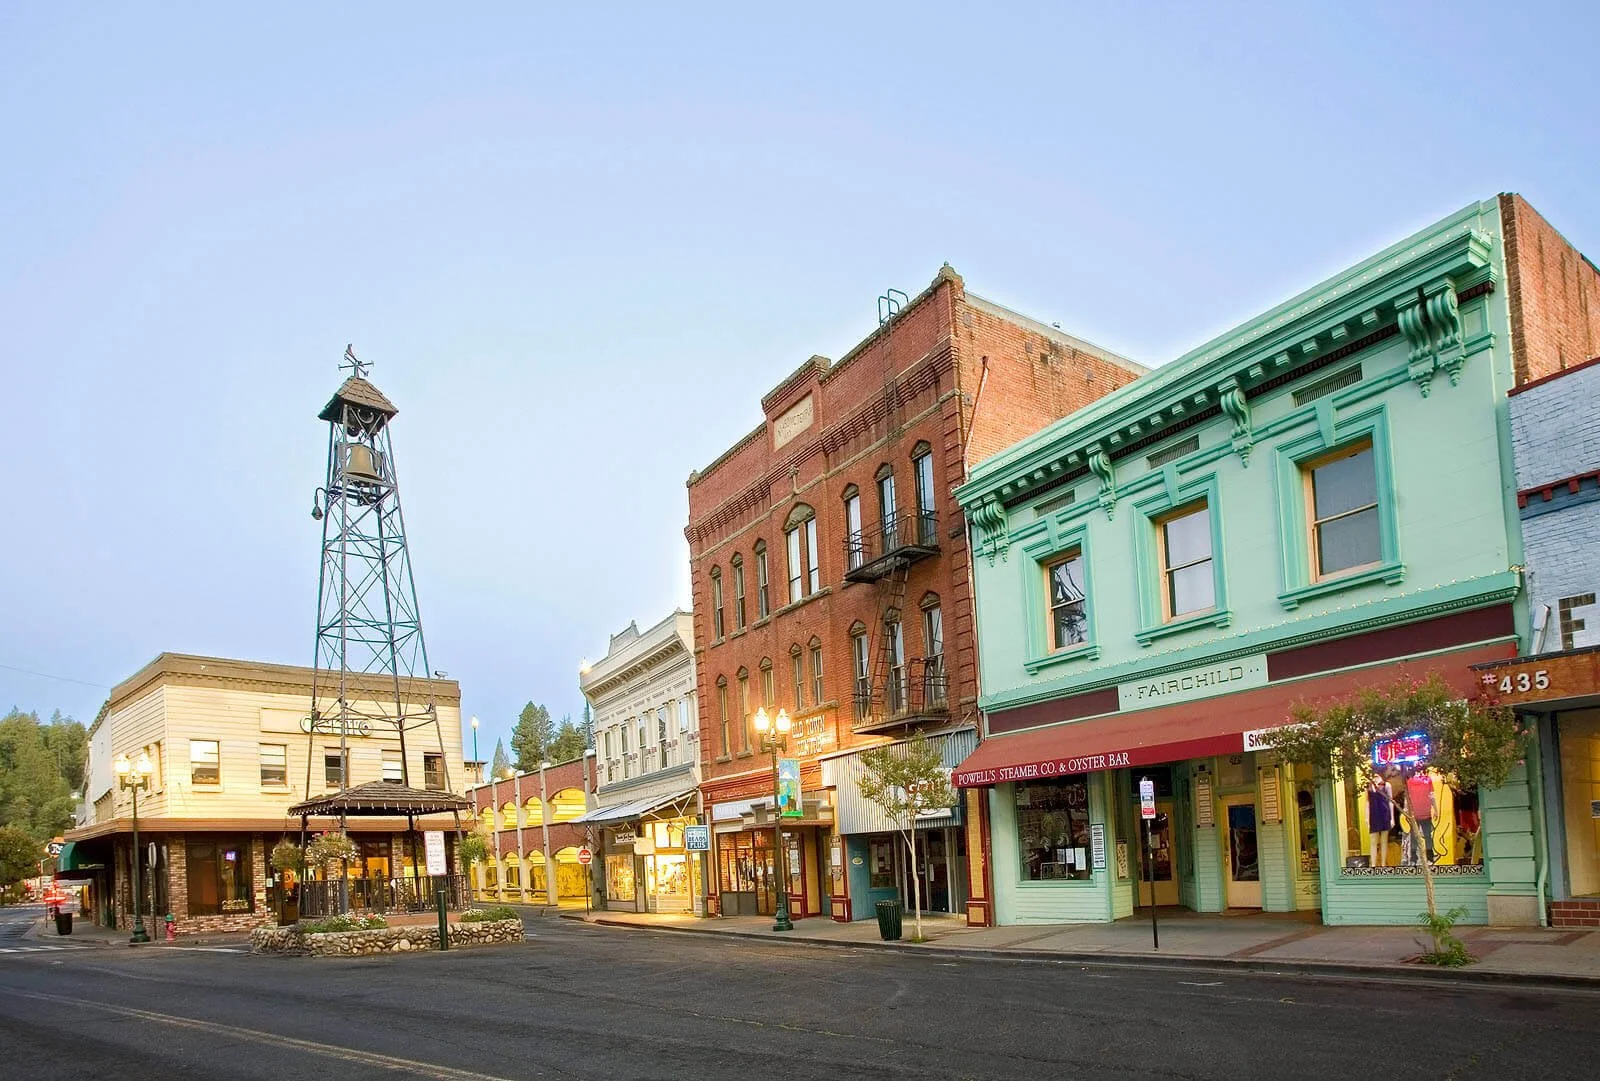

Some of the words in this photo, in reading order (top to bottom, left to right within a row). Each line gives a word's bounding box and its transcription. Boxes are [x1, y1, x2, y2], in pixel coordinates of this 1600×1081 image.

[1137, 666, 1243, 699] FAIRCHILD
[1481, 670, 1549, 694] #435
[792, 720, 804, 739] OLD
[805, 714, 825, 736] TOWN
[958, 769, 996, 785] POWELL'S
[999, 764, 1039, 780] STEAMER
[1040, 761, 1057, 774] CO.
[1059, 763, 1066, 773] &
[1068, 755, 1106, 771] OYSTER
[1108, 752, 1131, 767] BAR
[690, 841, 706, 849] PLUS
[1440, 866, 1454, 874] DVS
[1462, 865, 1477, 874] DVS
